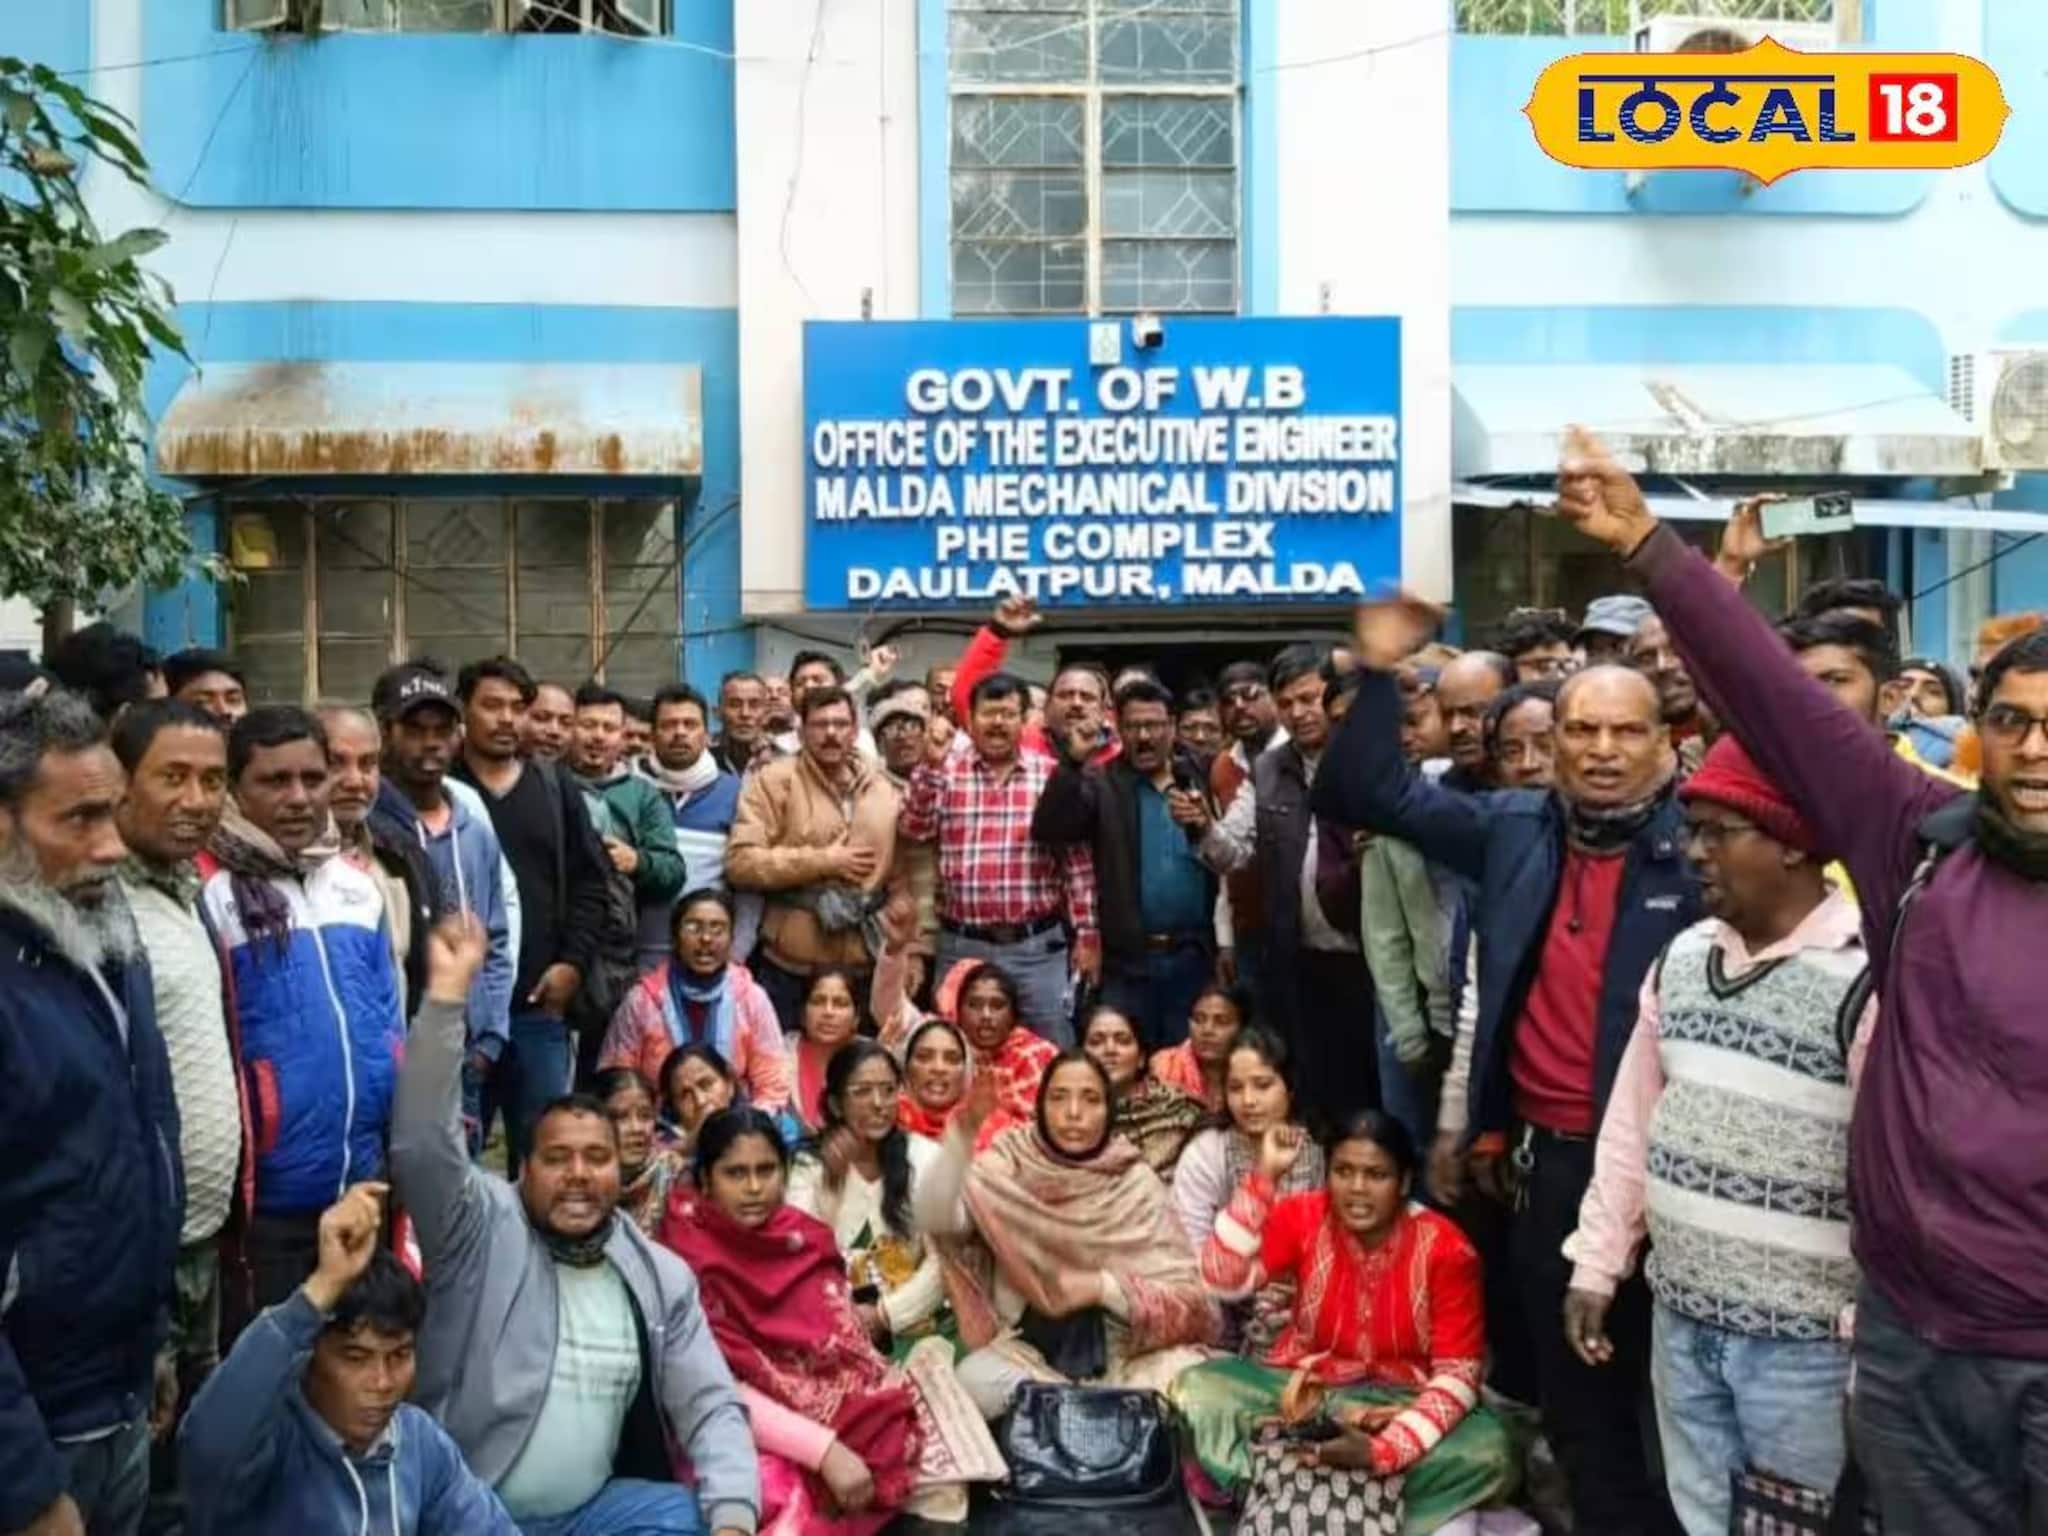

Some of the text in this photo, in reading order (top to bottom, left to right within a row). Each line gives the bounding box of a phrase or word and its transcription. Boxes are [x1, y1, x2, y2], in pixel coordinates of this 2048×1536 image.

[906, 365, 1306, 412] GOVT. OF W.B
[814, 414, 1398, 468] OFFICE OF THE EXECUTIVE ENGINEER
[815, 468, 1394, 520] MALDA MECHANICAL DIVISION
[936, 521, 1276, 562] PHE COMPLEX
[847, 561, 1366, 600] DAULATPUR, MALDA
